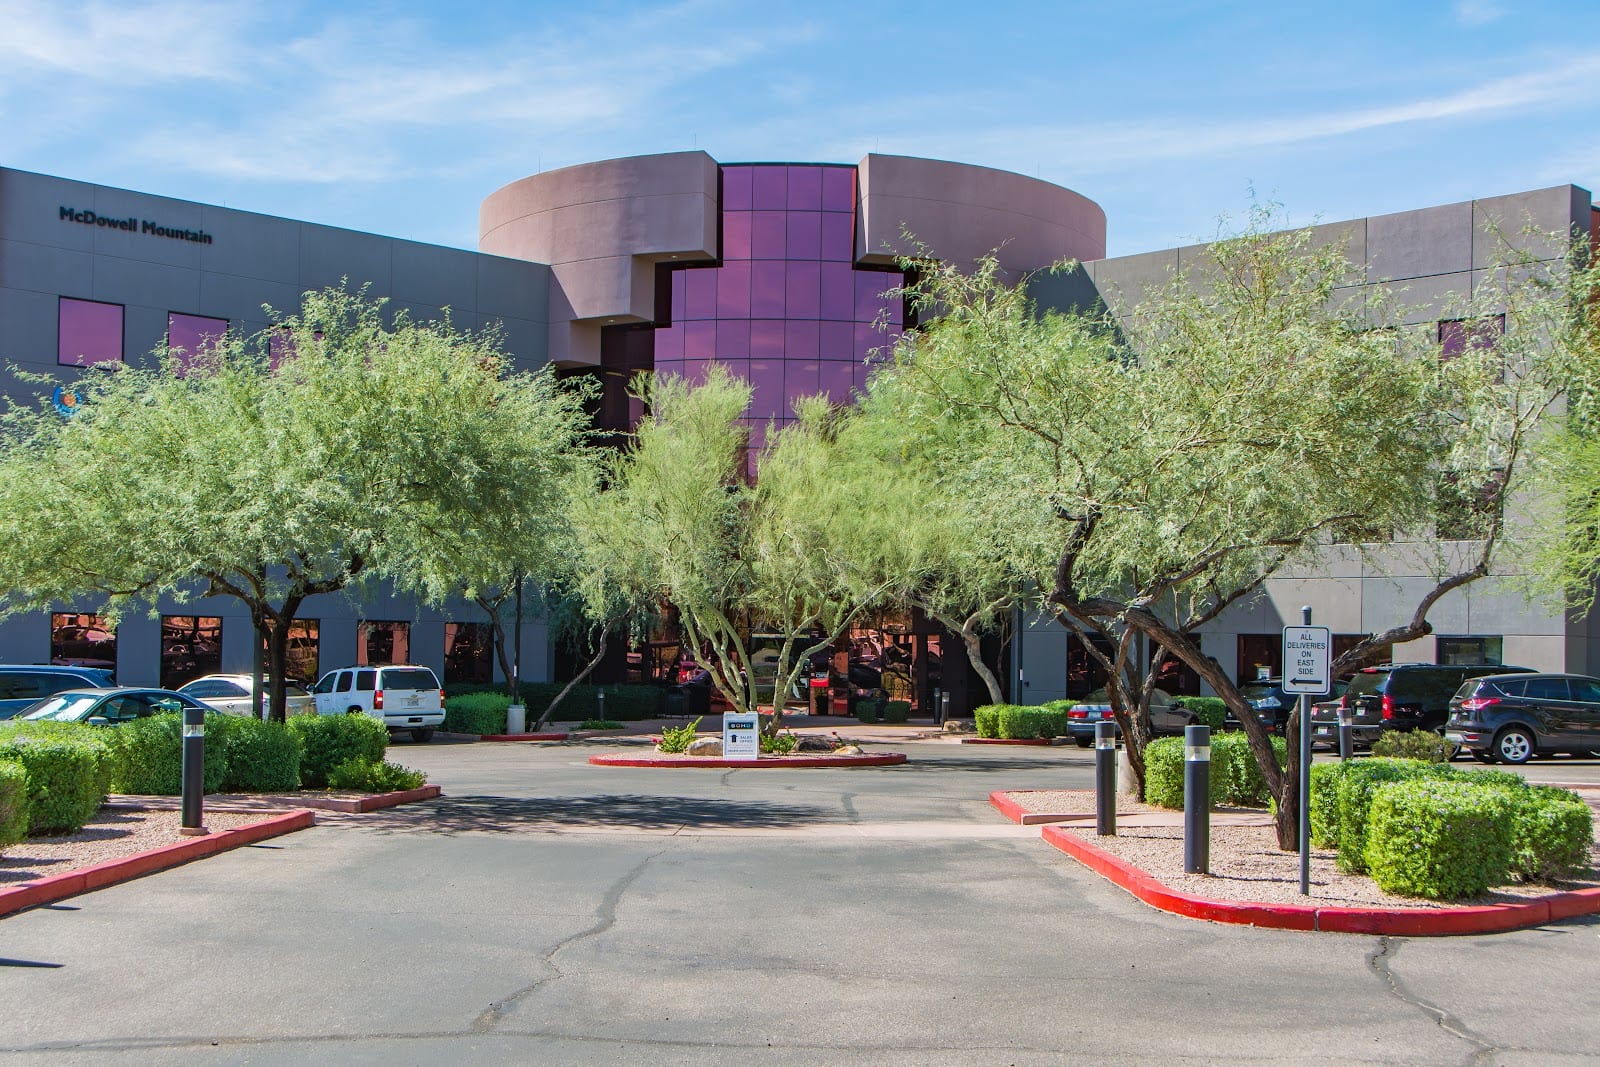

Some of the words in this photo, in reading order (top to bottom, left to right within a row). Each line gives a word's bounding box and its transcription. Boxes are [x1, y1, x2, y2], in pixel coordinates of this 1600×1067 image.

[58, 206, 138, 233] McDowell
[142, 219, 213, 245] Mountain
[1300, 633, 1313, 641] ALL
[1287, 641, 1326, 650] DELIVERIES
[1301, 650, 1312, 658] ON
[1297, 659, 1315, 667] EAST
[1297, 667, 1314, 675] SIDE
